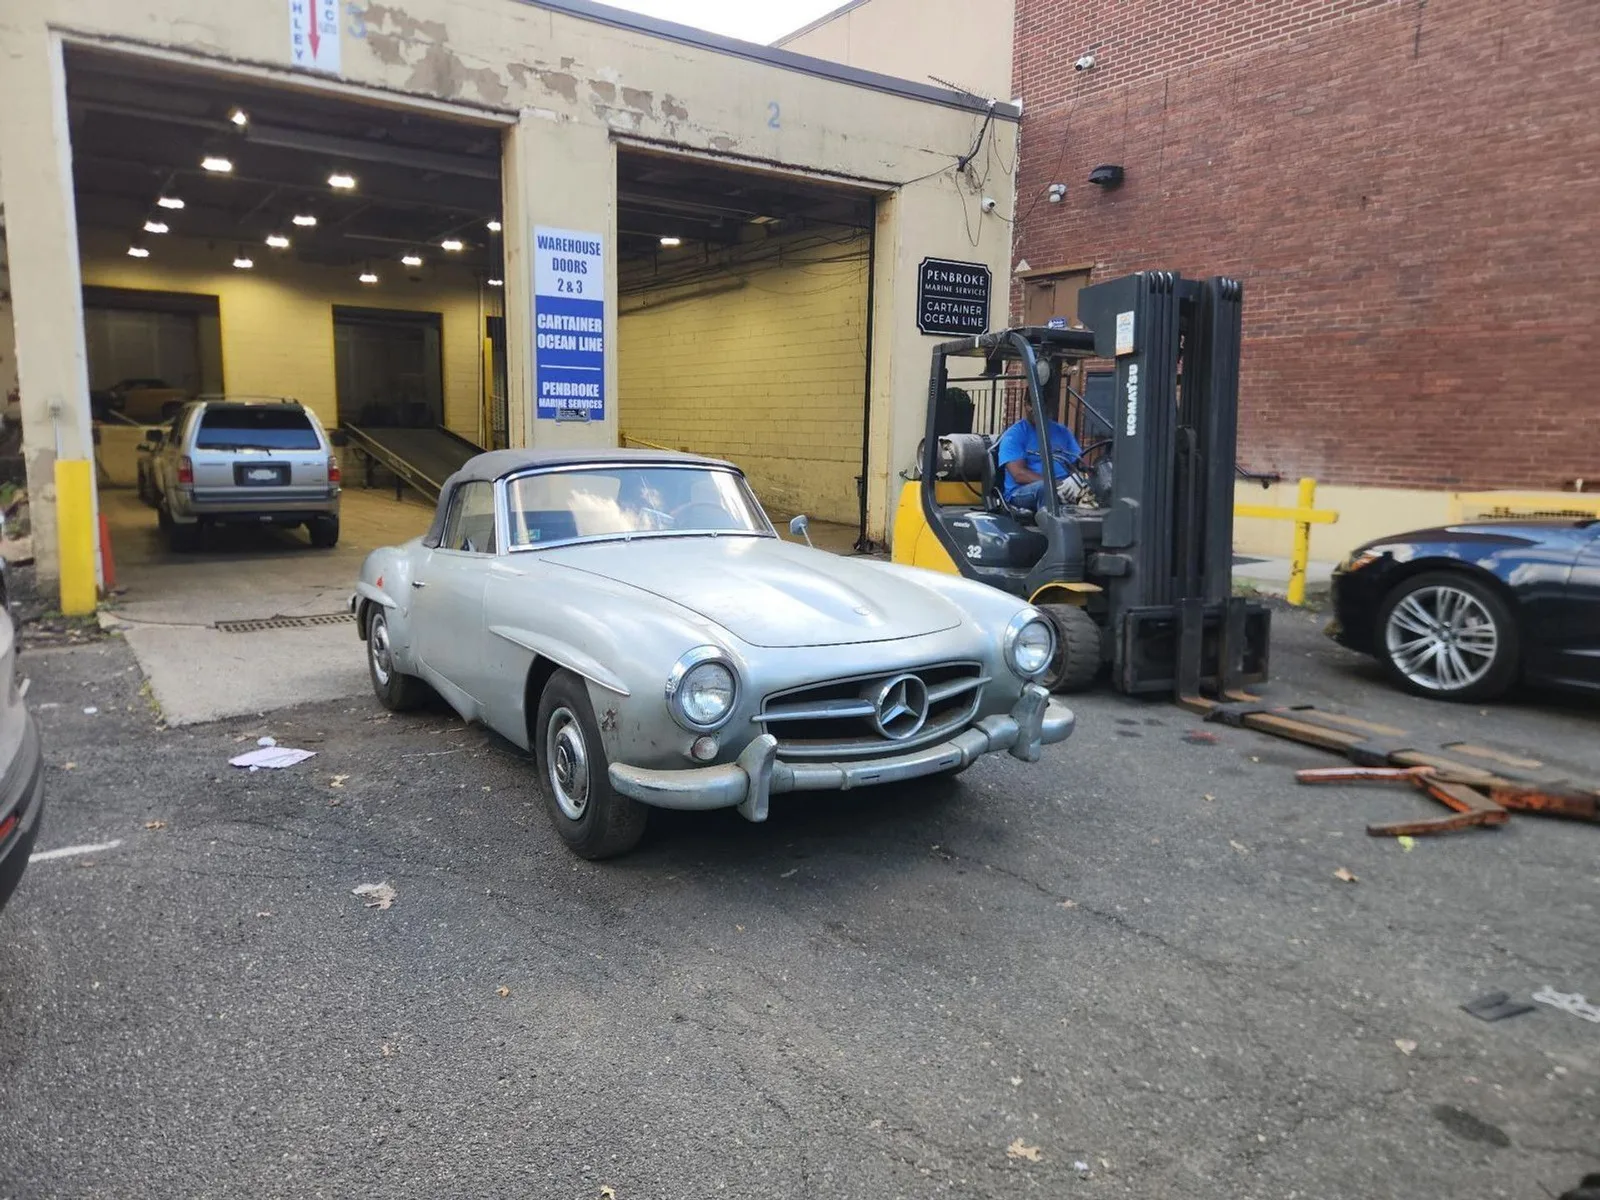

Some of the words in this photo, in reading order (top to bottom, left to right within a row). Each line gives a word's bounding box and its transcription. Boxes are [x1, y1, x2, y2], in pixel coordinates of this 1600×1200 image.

[767, 101, 780, 128] 2
[537, 235, 601, 256] WAREHOUSE
[552, 257, 588, 275] DOORS
[557, 278, 564, 292] 2
[566, 280, 574, 293] &
[576, 279, 583, 294] 3
[927, 269, 985, 286] PENBROKE
[924, 283, 953, 293] MARINE
[955, 287, 985, 296] SERVICES
[926, 301, 982, 315] CARTAINER
[537, 313, 603, 333] CARTAINER
[924, 313, 958, 325] OCEAN
[962, 317, 983, 327] LINE
[537, 333, 577, 351] OCEAN
[578, 337, 603, 352] LINE
[542, 381, 600, 398] PENBROKE
[538, 397, 568, 409] MARINE
[567, 398, 603, 410] SERVICES
[1126, 364, 1139, 436] KOMATSU
[967, 545, 981, 559] 32
